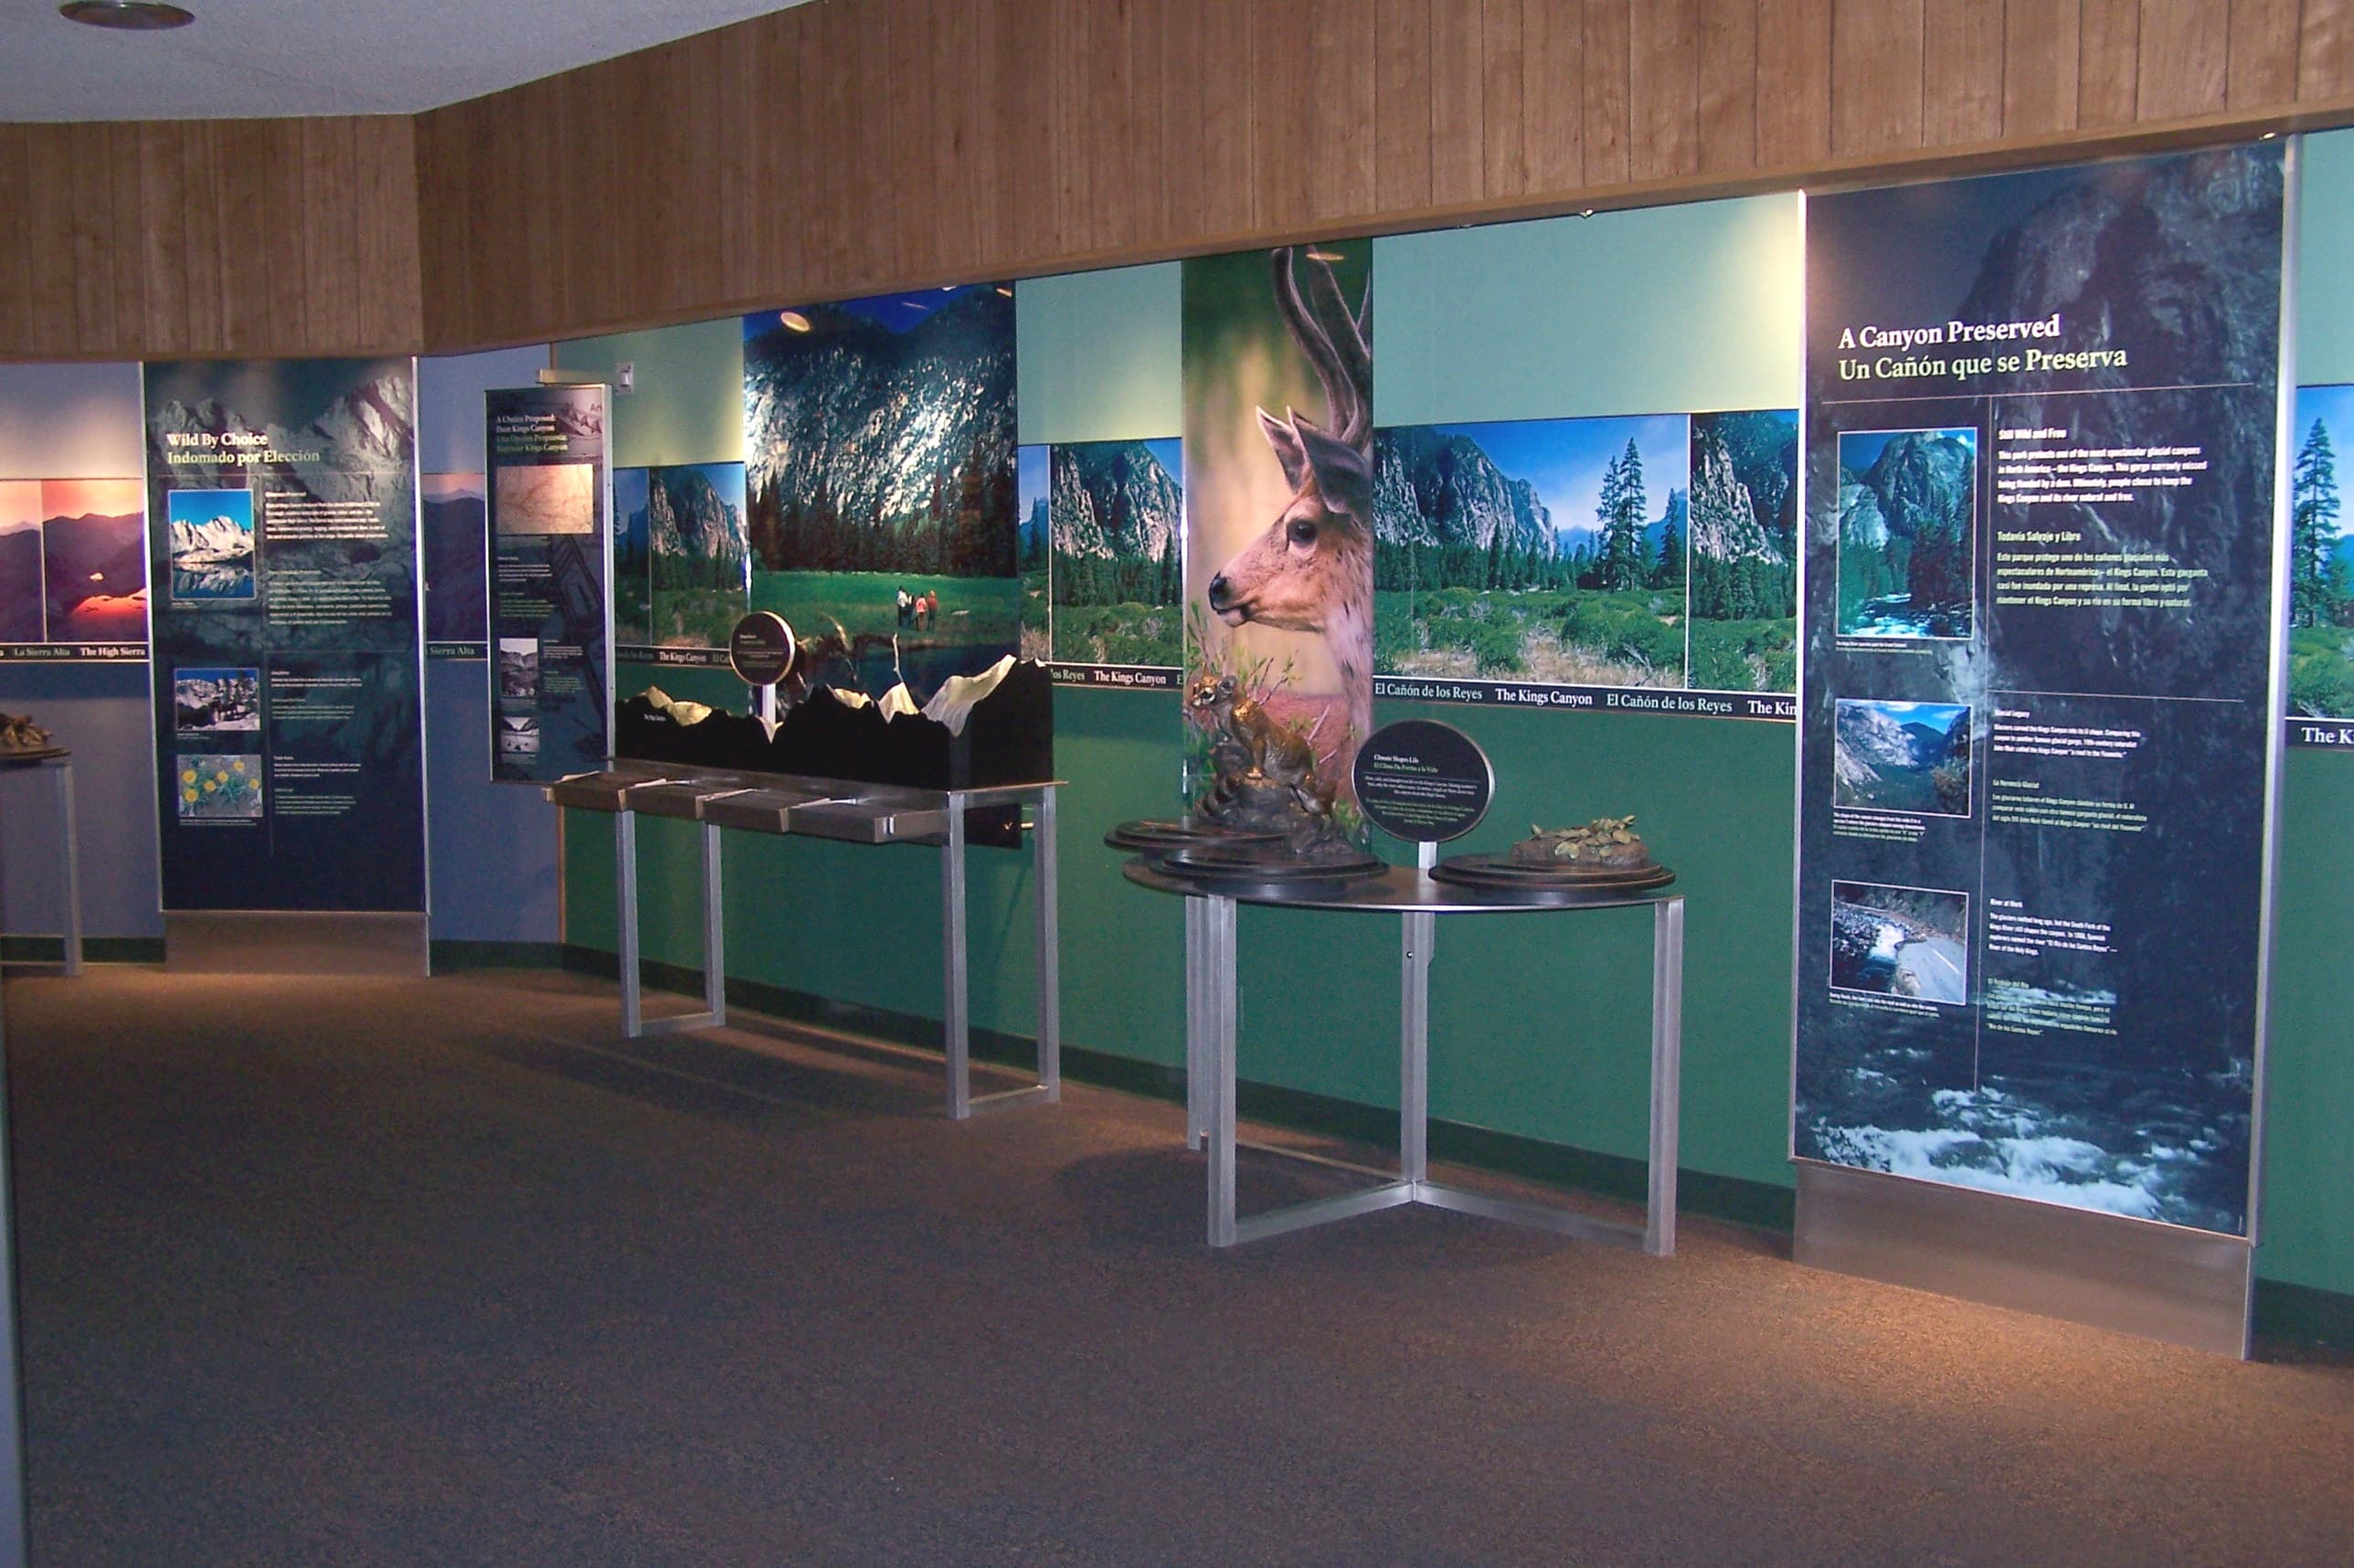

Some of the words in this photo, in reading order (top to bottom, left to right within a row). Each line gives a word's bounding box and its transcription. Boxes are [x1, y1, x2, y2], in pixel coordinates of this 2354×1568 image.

[1839, 327, 1854, 349] A
[1859, 325, 1943, 351] Canyon
[1947, 313, 2061, 343] Preserved
[1839, 358, 1871, 380] Un
[1874, 354, 1946, 377] Cañón
[1952, 358, 1991, 379] que
[1995, 357, 2020, 371] se
[2024, 347, 2127, 372] Preserva
[166, 433, 198, 446] Wild
[202, 433, 219, 449] By
[221, 432, 268, 446] Choice
[1999, 429, 2014, 440] Still
[2014, 429, 2031, 439] Wild
[2032, 429, 2047, 439] and
[2048, 428, 2067, 439] Free
[167, 451, 235, 464] Indomado
[237, 455, 261, 467] por
[263, 449, 320, 463] Elección
[1998, 531, 2026, 541] Todavía
[2026, 531, 2053, 542] Salvaje
[2054, 533, 2060, 543] y
[2061, 531, 2082, 541] Libre
[15, 647, 26, 656] La
[26, 647, 52, 656] Sierra
[53, 647, 70, 656] Alta
[80, 647, 97, 656] The
[98, 647, 120, 658] High
[121, 647, 146, 656] Sierra
[429, 646, 456, 655] Sierra
[457, 646, 475, 655] Alta
[660, 651, 670, 661] The
[670, 652, 685, 663] Kings
[685, 652, 707, 664] Canyon
[1063, 669, 1086, 683] Reyes
[1094, 670, 1109, 682] The
[1110, 671, 1134, 685] Kings
[1135, 673, 1166, 686] Canyon
[1374, 683, 1385, 694] El
[1387, 683, 1419, 696] Cañón
[1422, 685, 1434, 697] de
[1436, 685, 1451, 698] los
[1453, 686, 1483, 702] Reyes
[1495, 688, 1516, 701] The
[1518, 690, 1548, 705] Kings
[1550, 691, 1594, 707] Canyon
[1606, 694, 1618, 706] El
[1621, 694, 1659, 708] Cañón
[1661, 696, 1676, 709] de
[1678, 696, 1695, 710] los
[1697, 698, 1733, 715] Reyes
[1747, 700, 1773, 715] The
[1775, 702, 1797, 715] Kin
[2301, 726, 2335, 743] The
